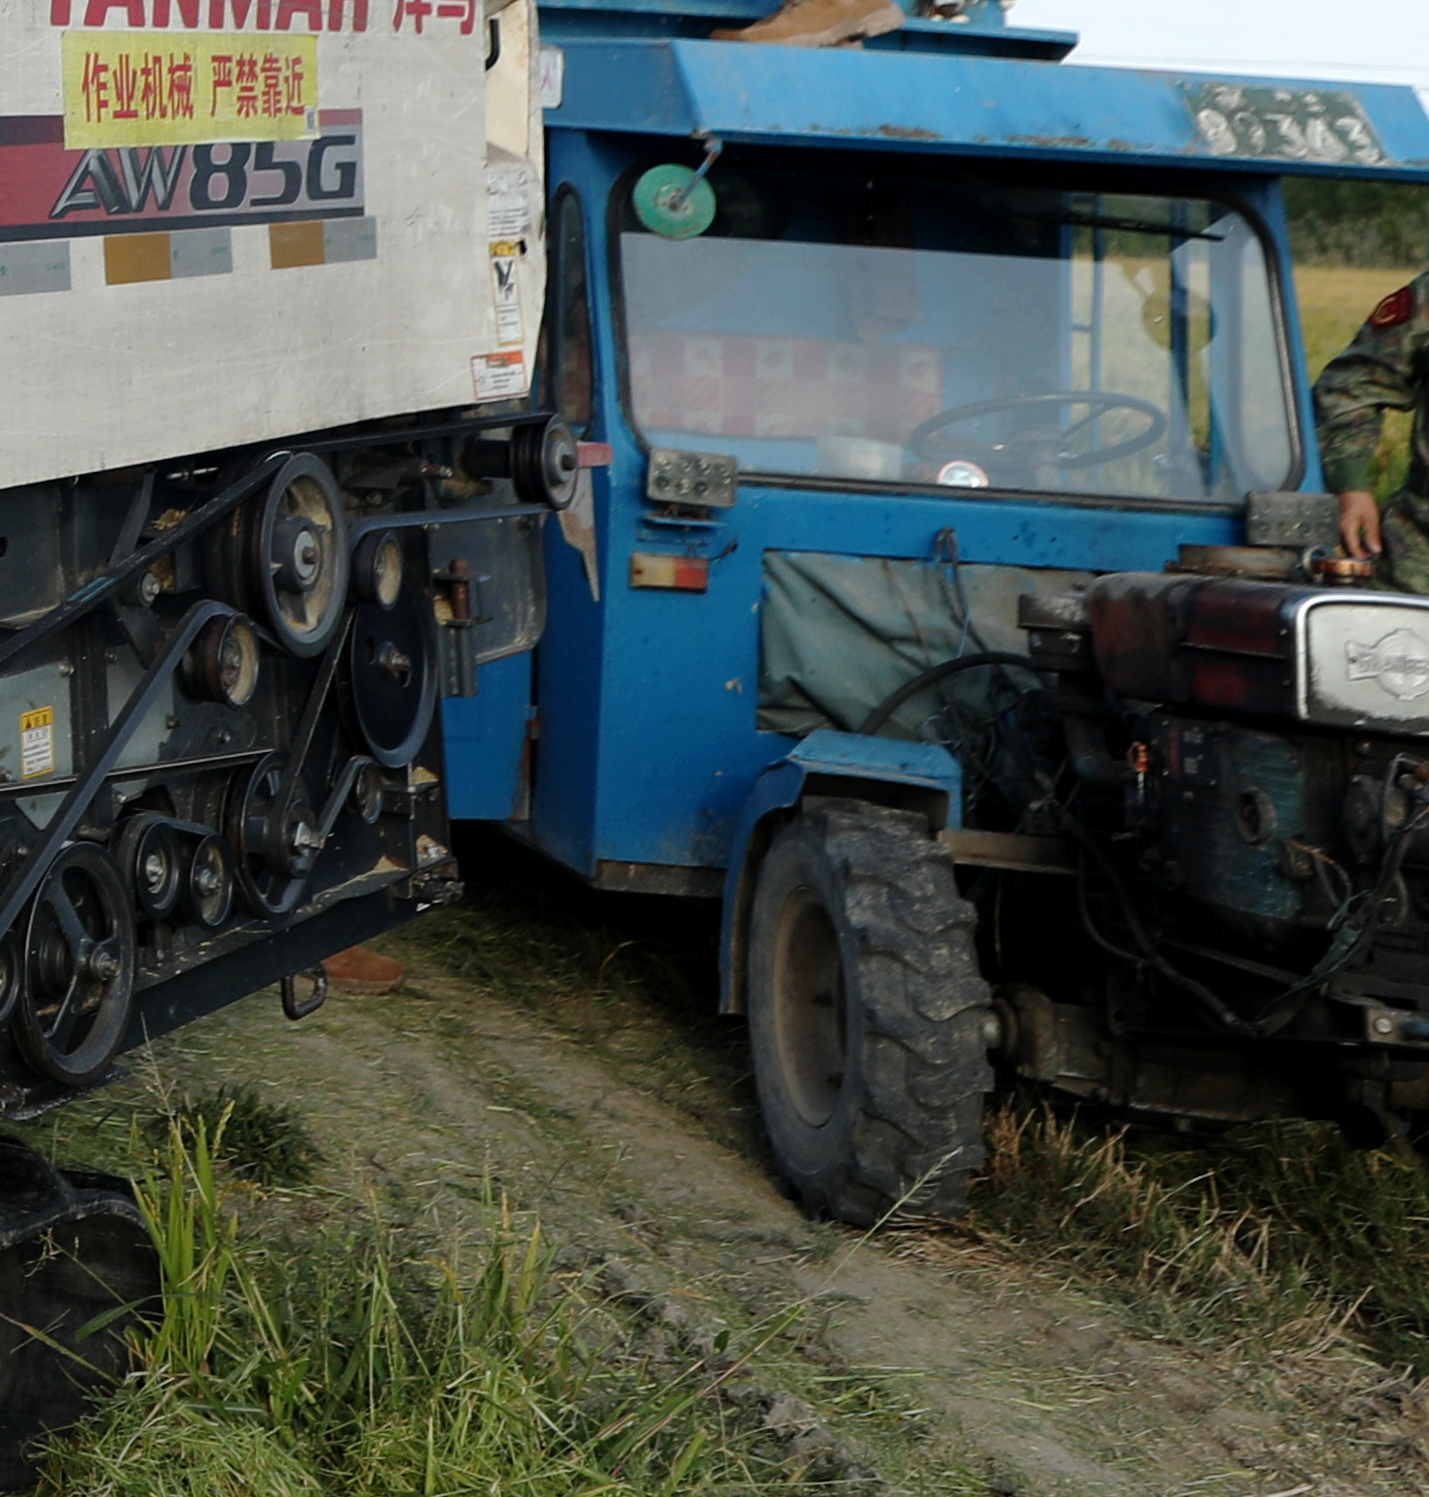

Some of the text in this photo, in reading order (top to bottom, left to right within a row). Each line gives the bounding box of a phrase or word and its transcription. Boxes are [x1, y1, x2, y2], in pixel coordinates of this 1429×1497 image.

[81, 51, 307, 124] 作业机械 严禁靠近
[48, 134, 357, 220] AW85G
